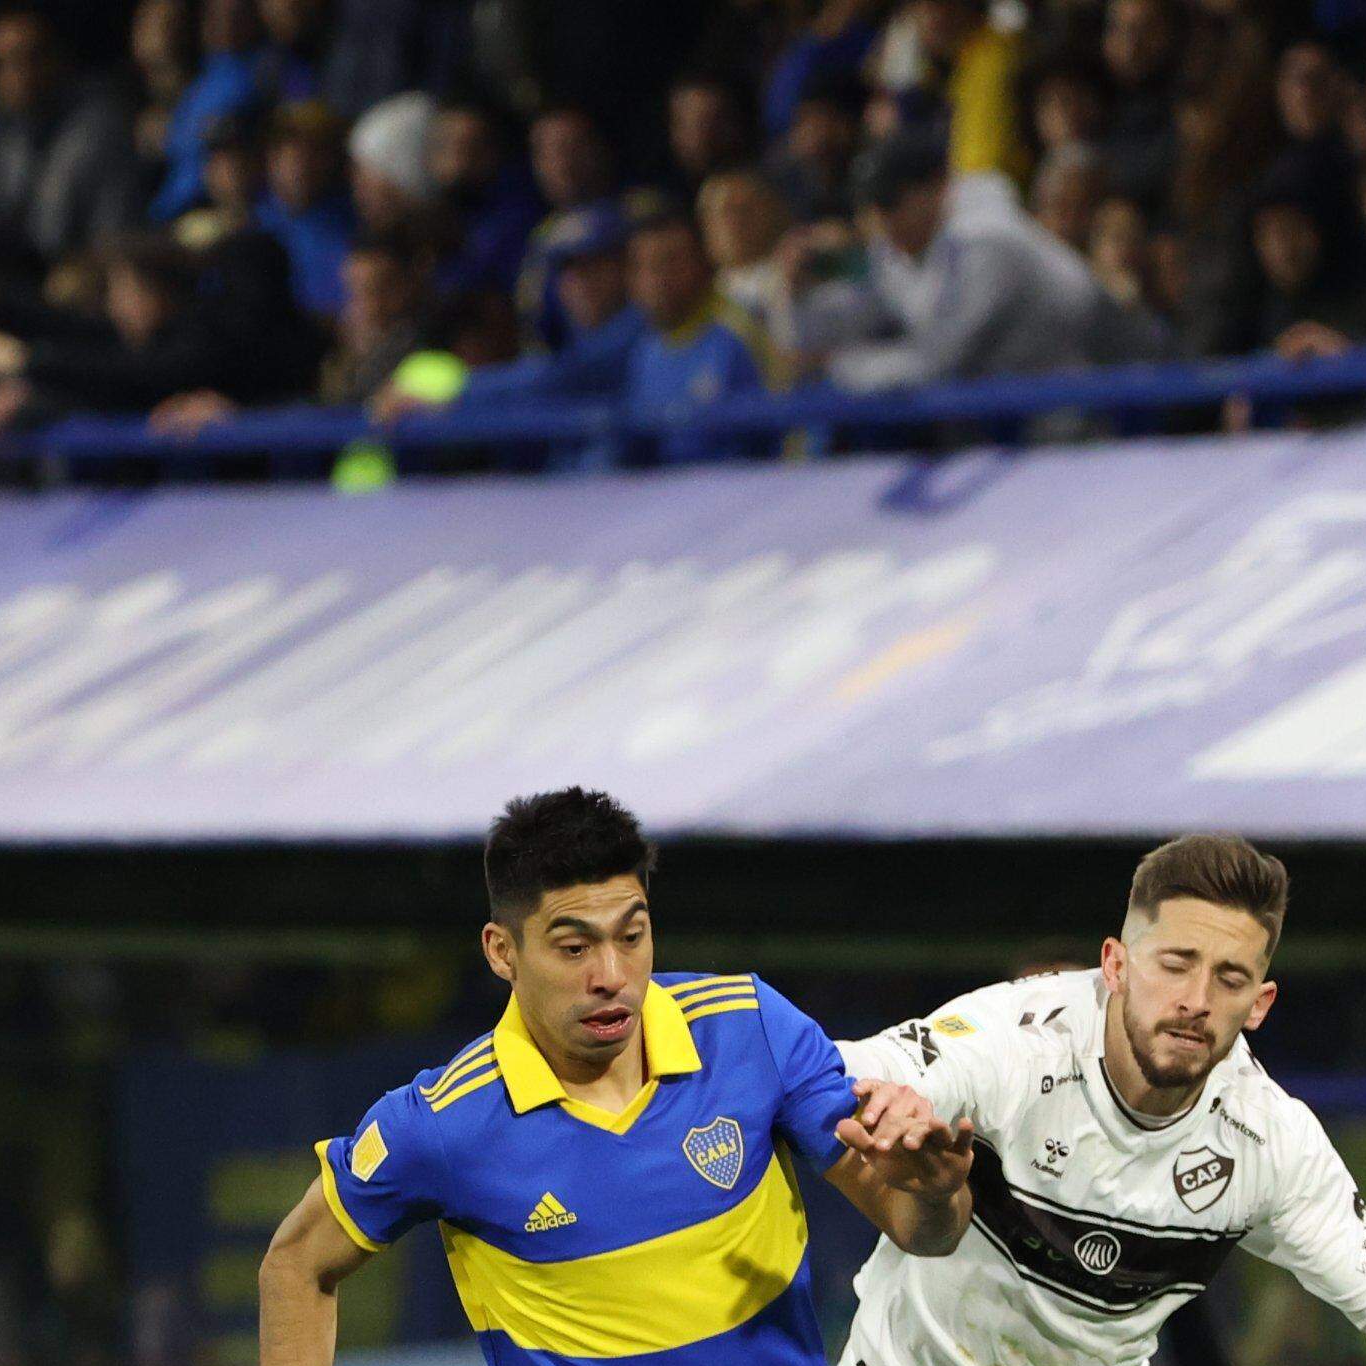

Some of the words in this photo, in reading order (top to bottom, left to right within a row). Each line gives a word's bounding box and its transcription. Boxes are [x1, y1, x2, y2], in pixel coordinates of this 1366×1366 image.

[695, 1138, 737, 1167] CABJ
[1181, 1161, 1223, 1191] CAP
[525, 1212, 578, 1233] adidas
